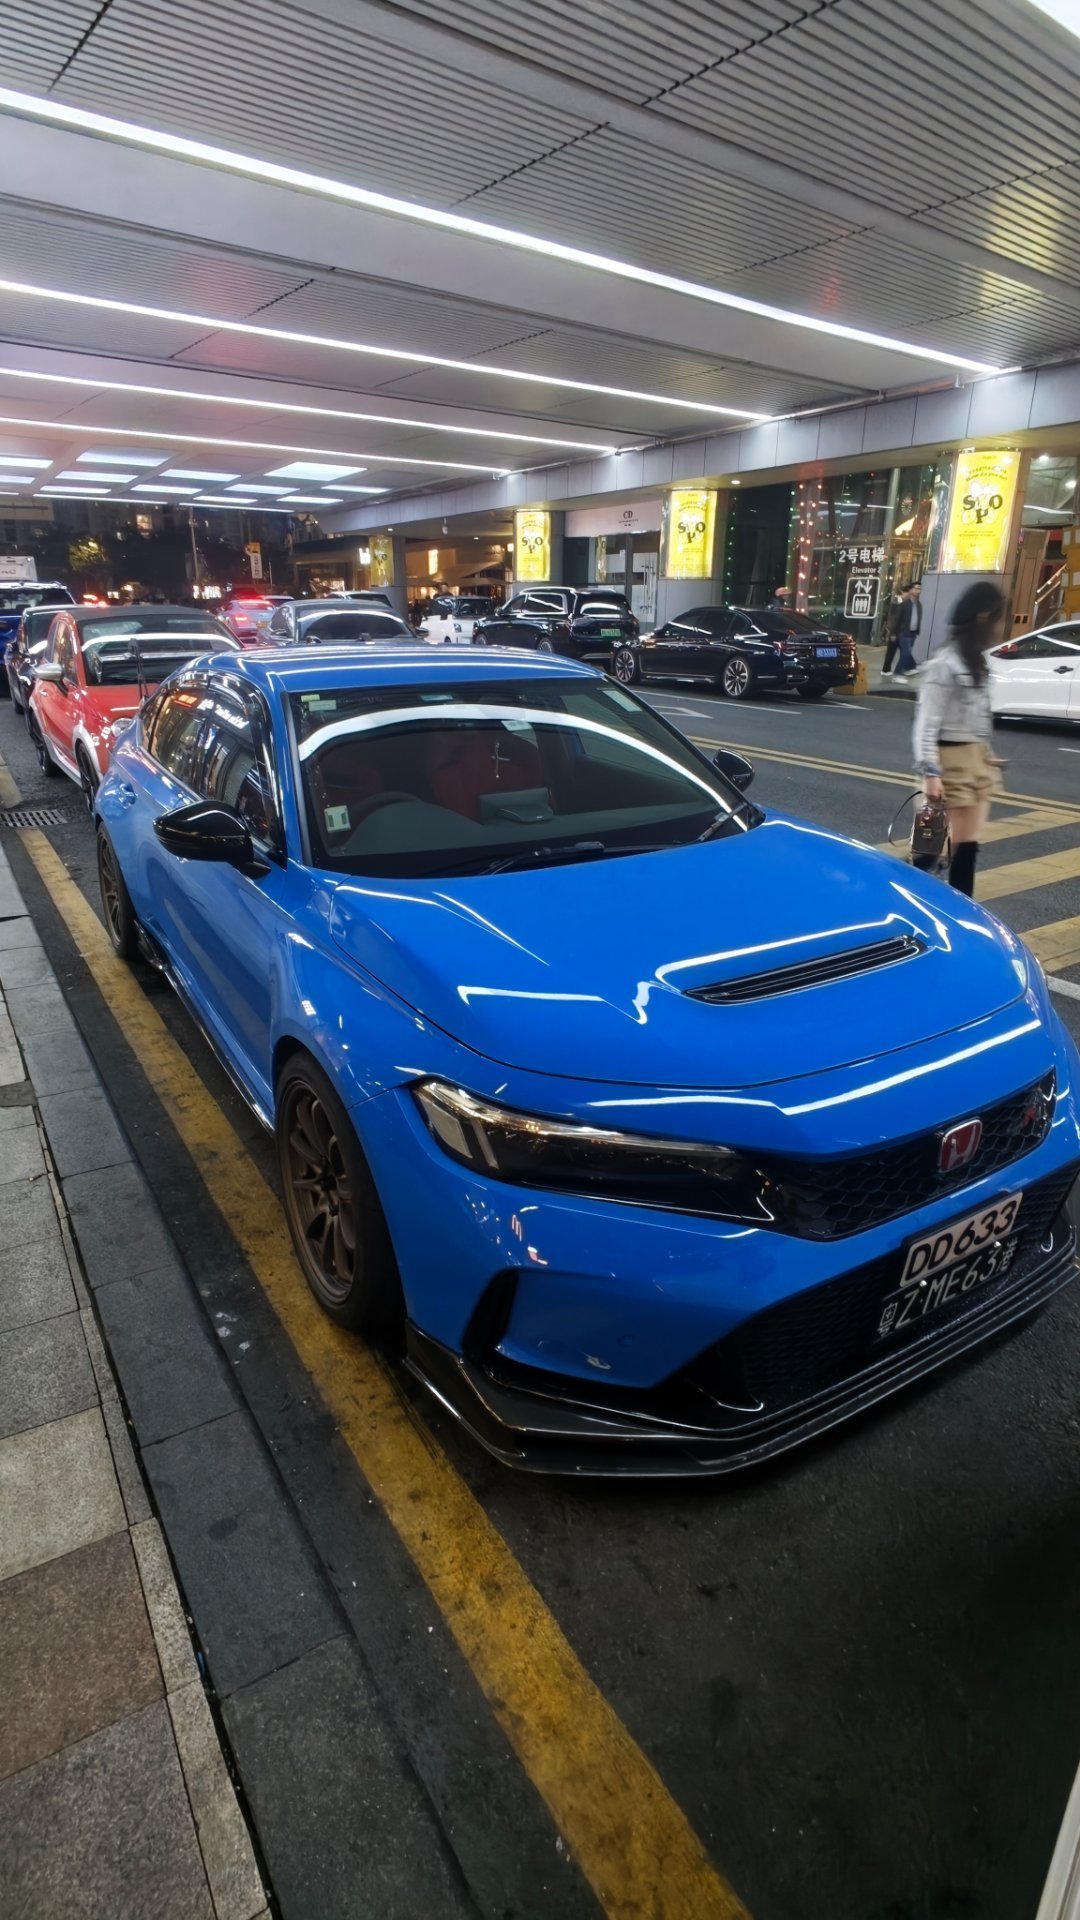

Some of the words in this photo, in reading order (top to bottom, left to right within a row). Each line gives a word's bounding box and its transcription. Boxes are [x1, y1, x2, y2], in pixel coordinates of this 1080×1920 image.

[838, 546, 885, 564] 2号电梯
[851, 565, 877, 575] Elevator
[905, 1200, 1018, 1281] DD633
